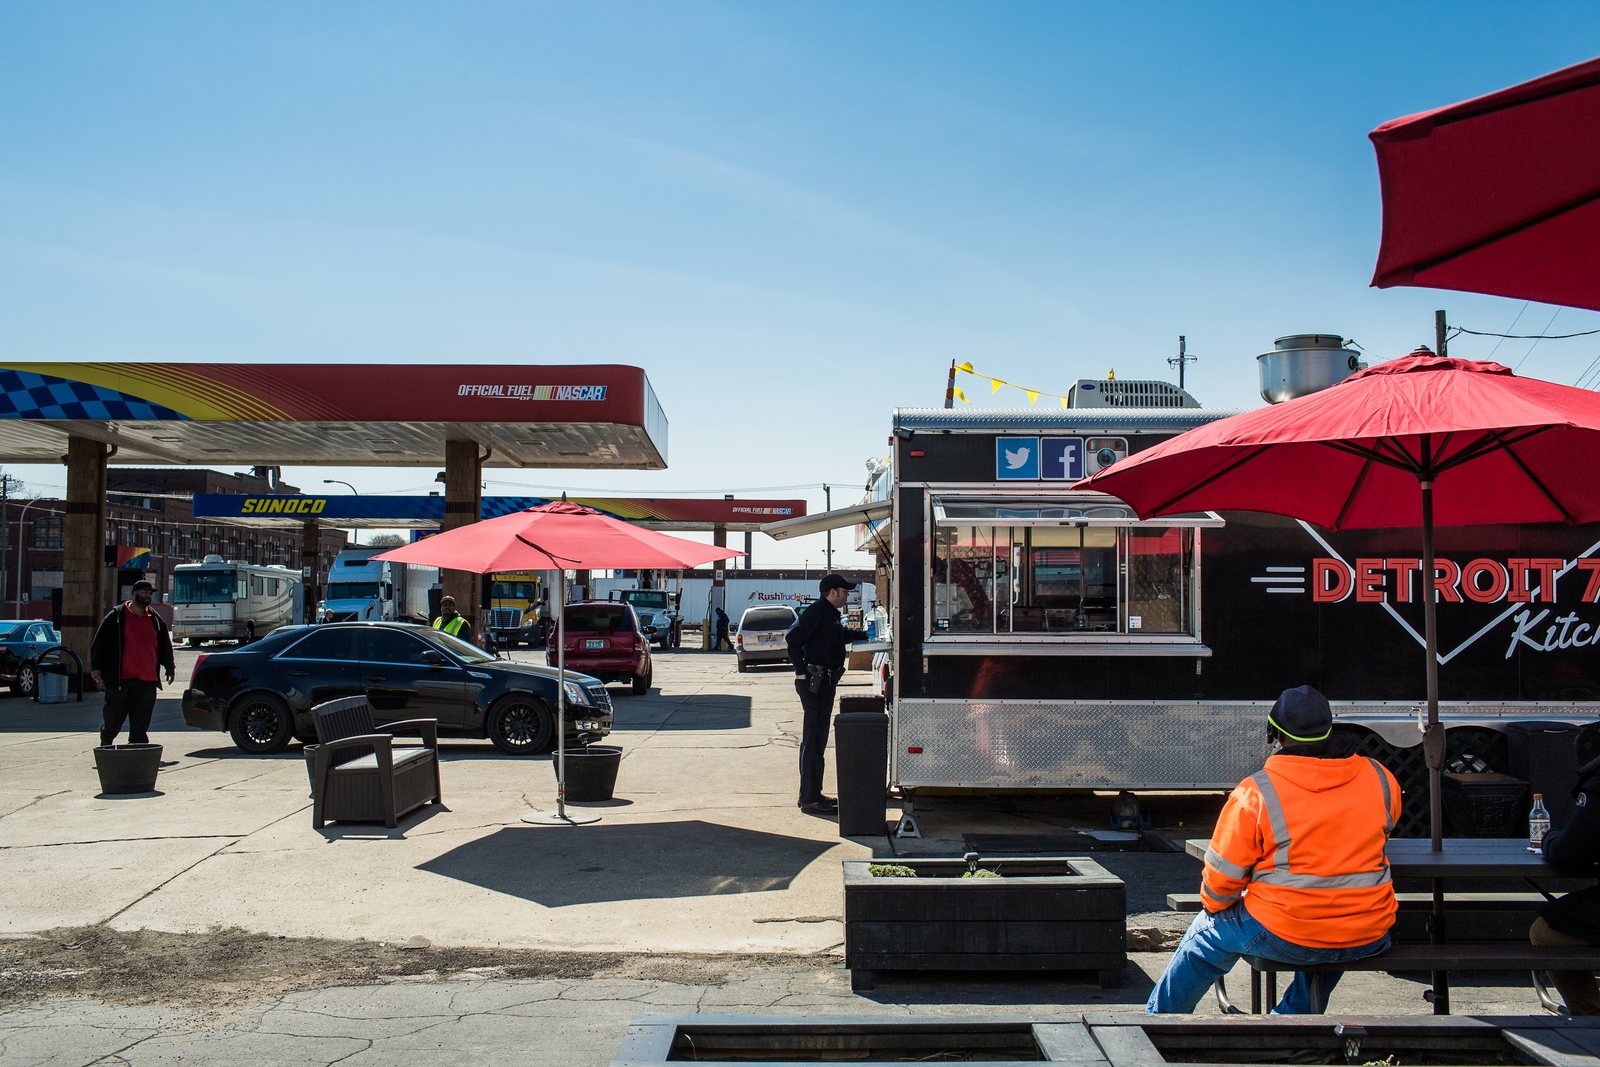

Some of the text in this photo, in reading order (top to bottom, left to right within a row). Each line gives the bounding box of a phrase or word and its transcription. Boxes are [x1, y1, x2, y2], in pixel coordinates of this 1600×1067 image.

[457, 384, 533, 396] OFFICIAL FUEL
[556, 386, 603, 400] NASCAR
[241, 498, 327, 514] SUNOCO
[1312, 557, 1565, 604] DETROIT
[758, 592, 811, 601] RushTruckng
[1505, 608, 1600, 660] Kitc
